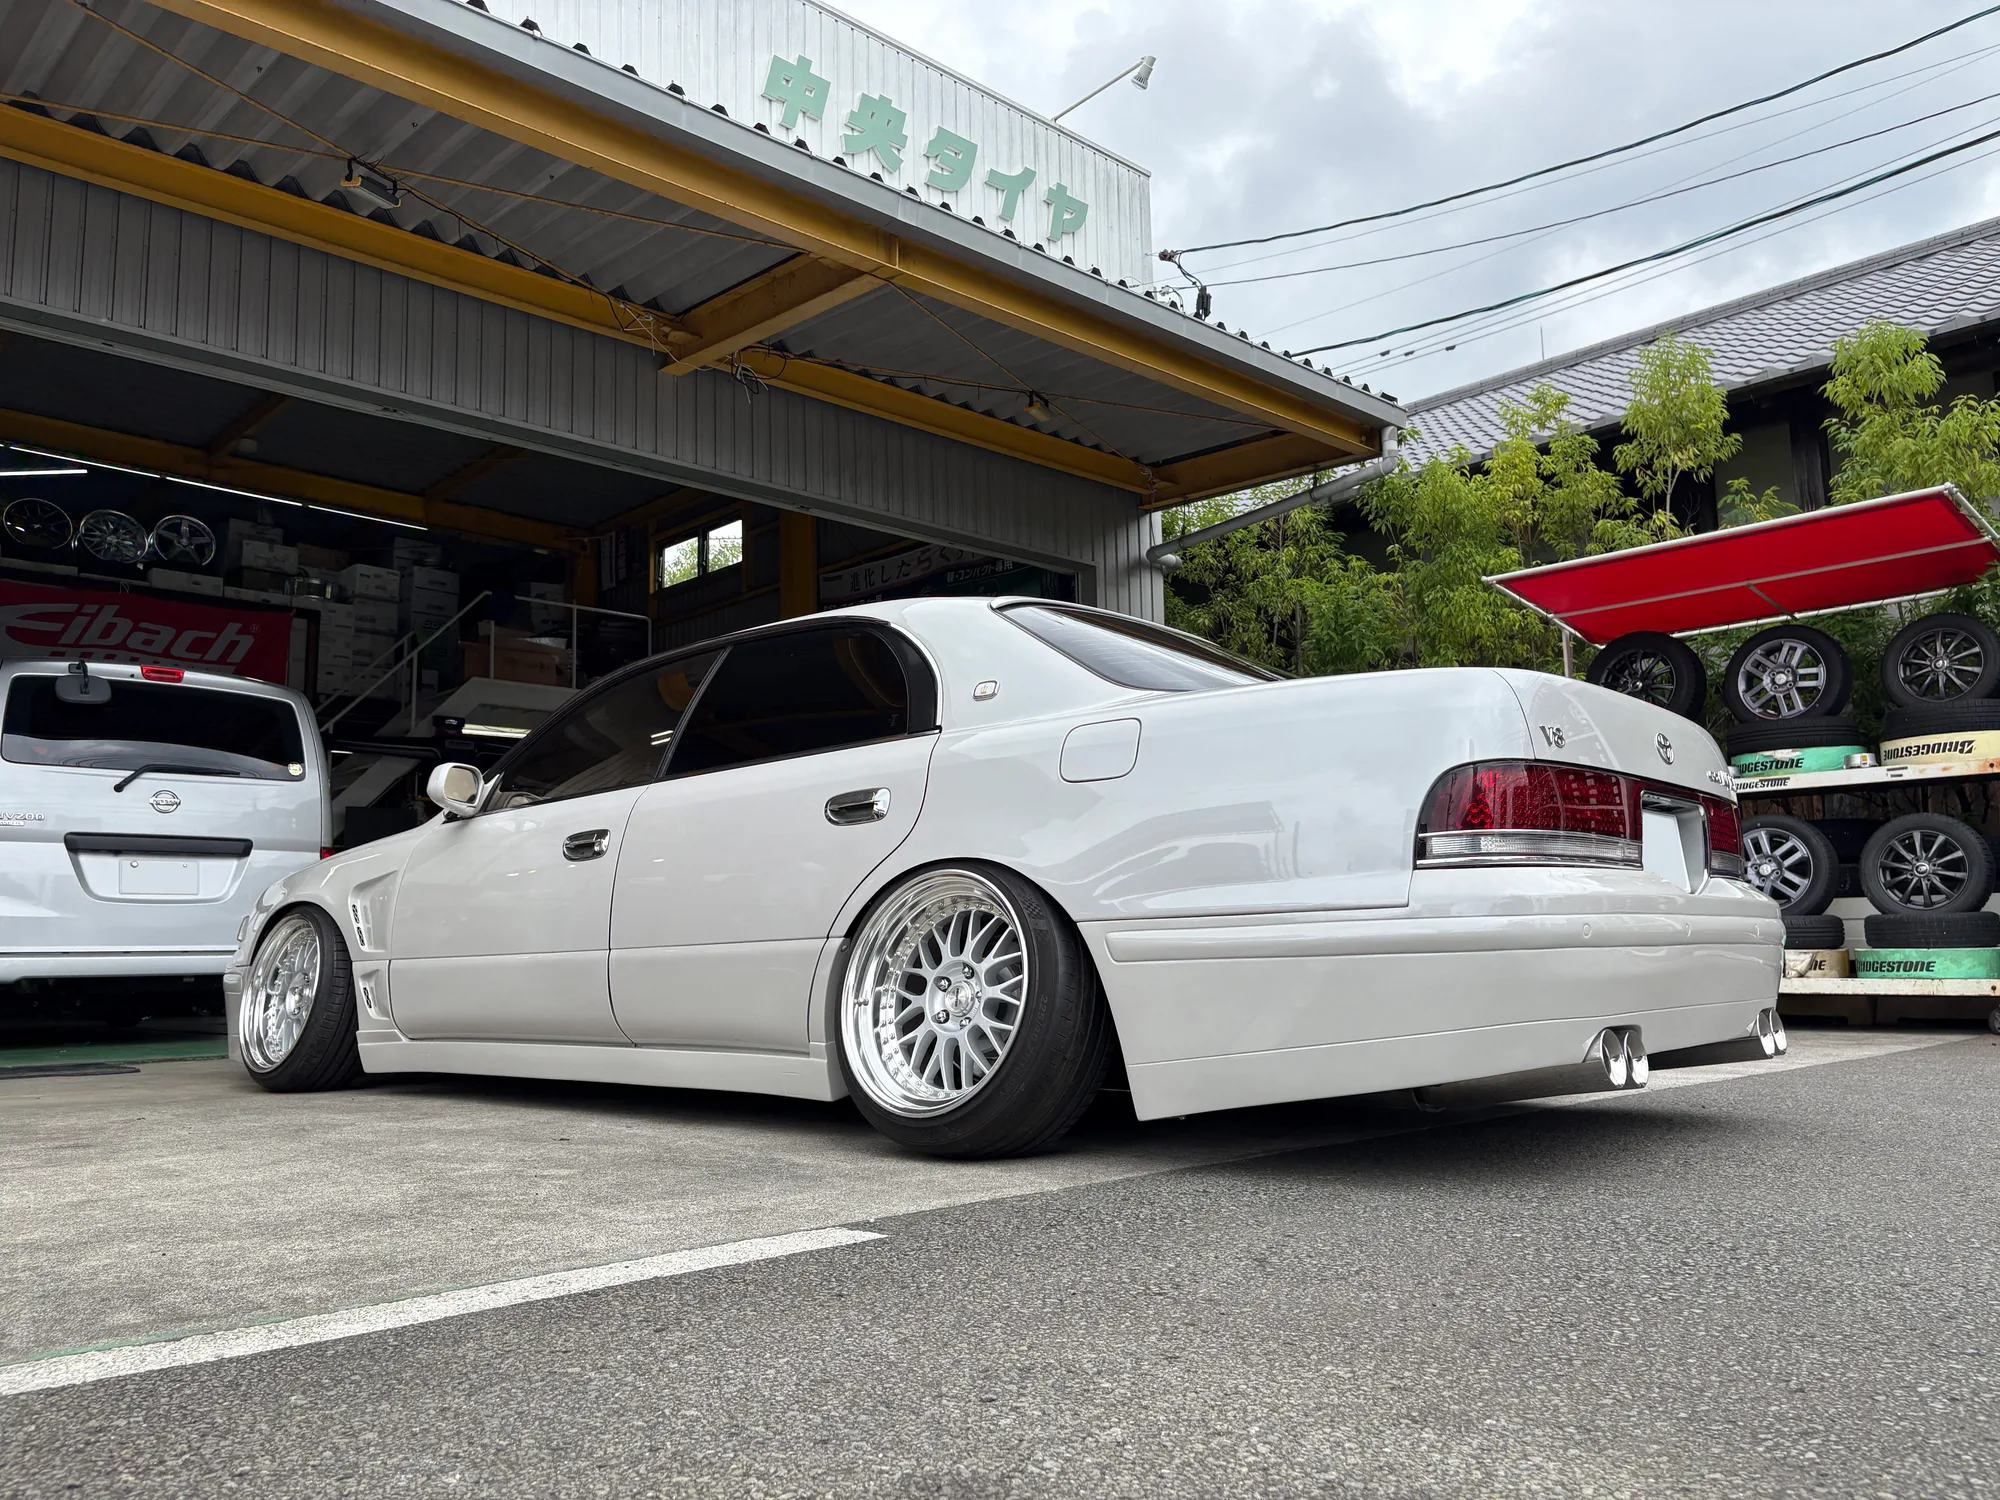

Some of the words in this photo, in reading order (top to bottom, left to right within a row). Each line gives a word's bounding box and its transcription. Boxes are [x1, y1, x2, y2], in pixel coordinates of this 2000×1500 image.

[761, 54, 1089, 242] 中央タイヤ
[0, 602, 255, 664] Eibach
[1538, 725, 1566, 749] V8
[1884, 740, 1976, 761] BRIDGESTONE
[1735, 757, 1805, 774] IDGESTONE
[1734, 778, 1789, 791] RIDGESTONE
